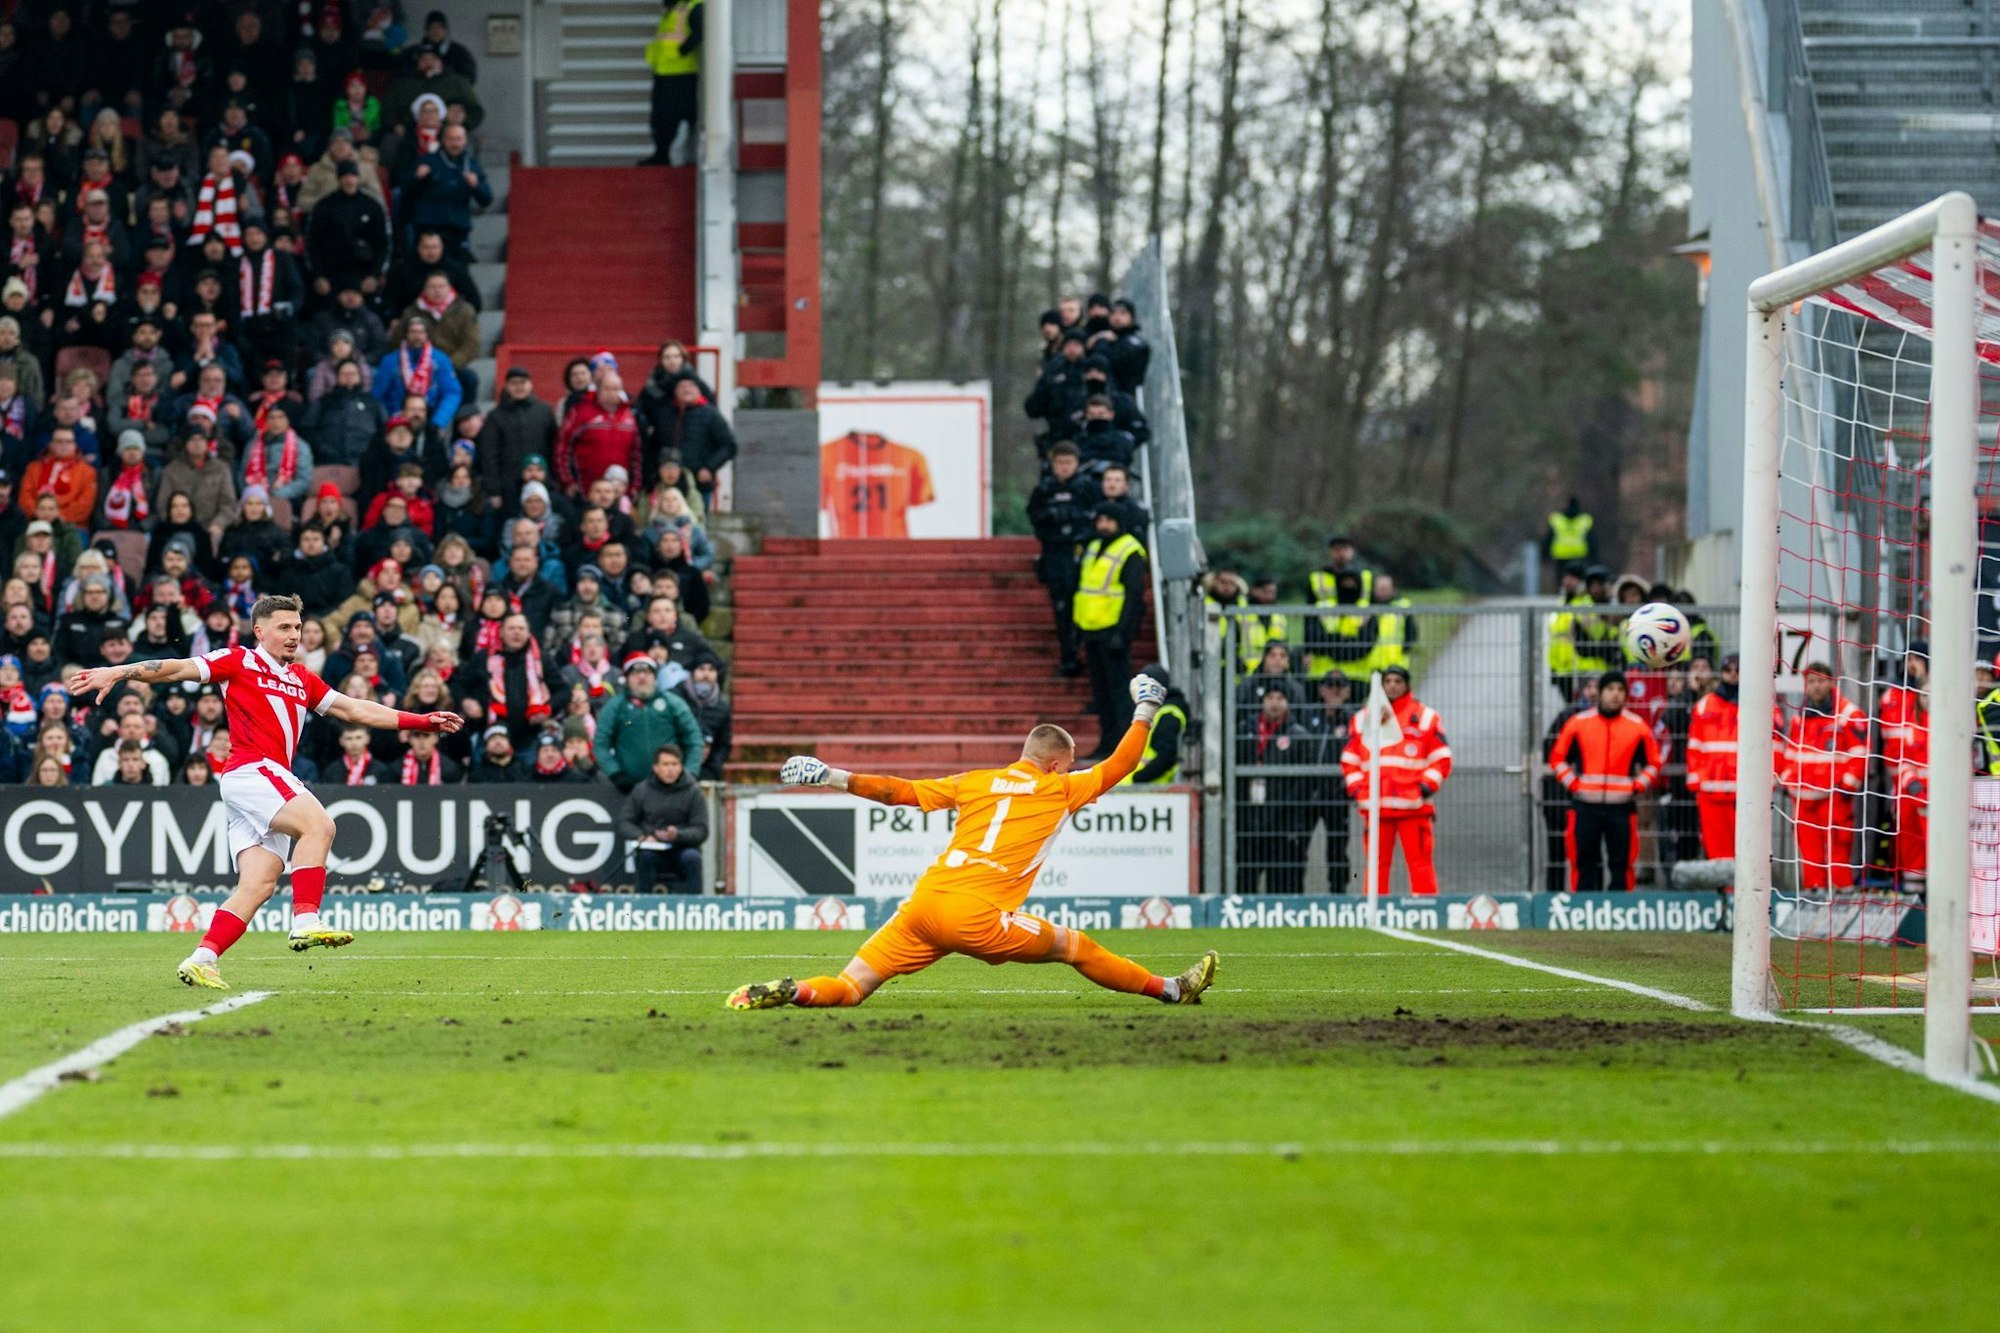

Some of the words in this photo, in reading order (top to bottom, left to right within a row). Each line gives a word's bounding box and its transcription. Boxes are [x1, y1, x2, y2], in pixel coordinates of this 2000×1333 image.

[4, 799, 230, 875] GYM
[976, 796, 1012, 853] 1
[1072, 806, 1173, 833] GmbH
